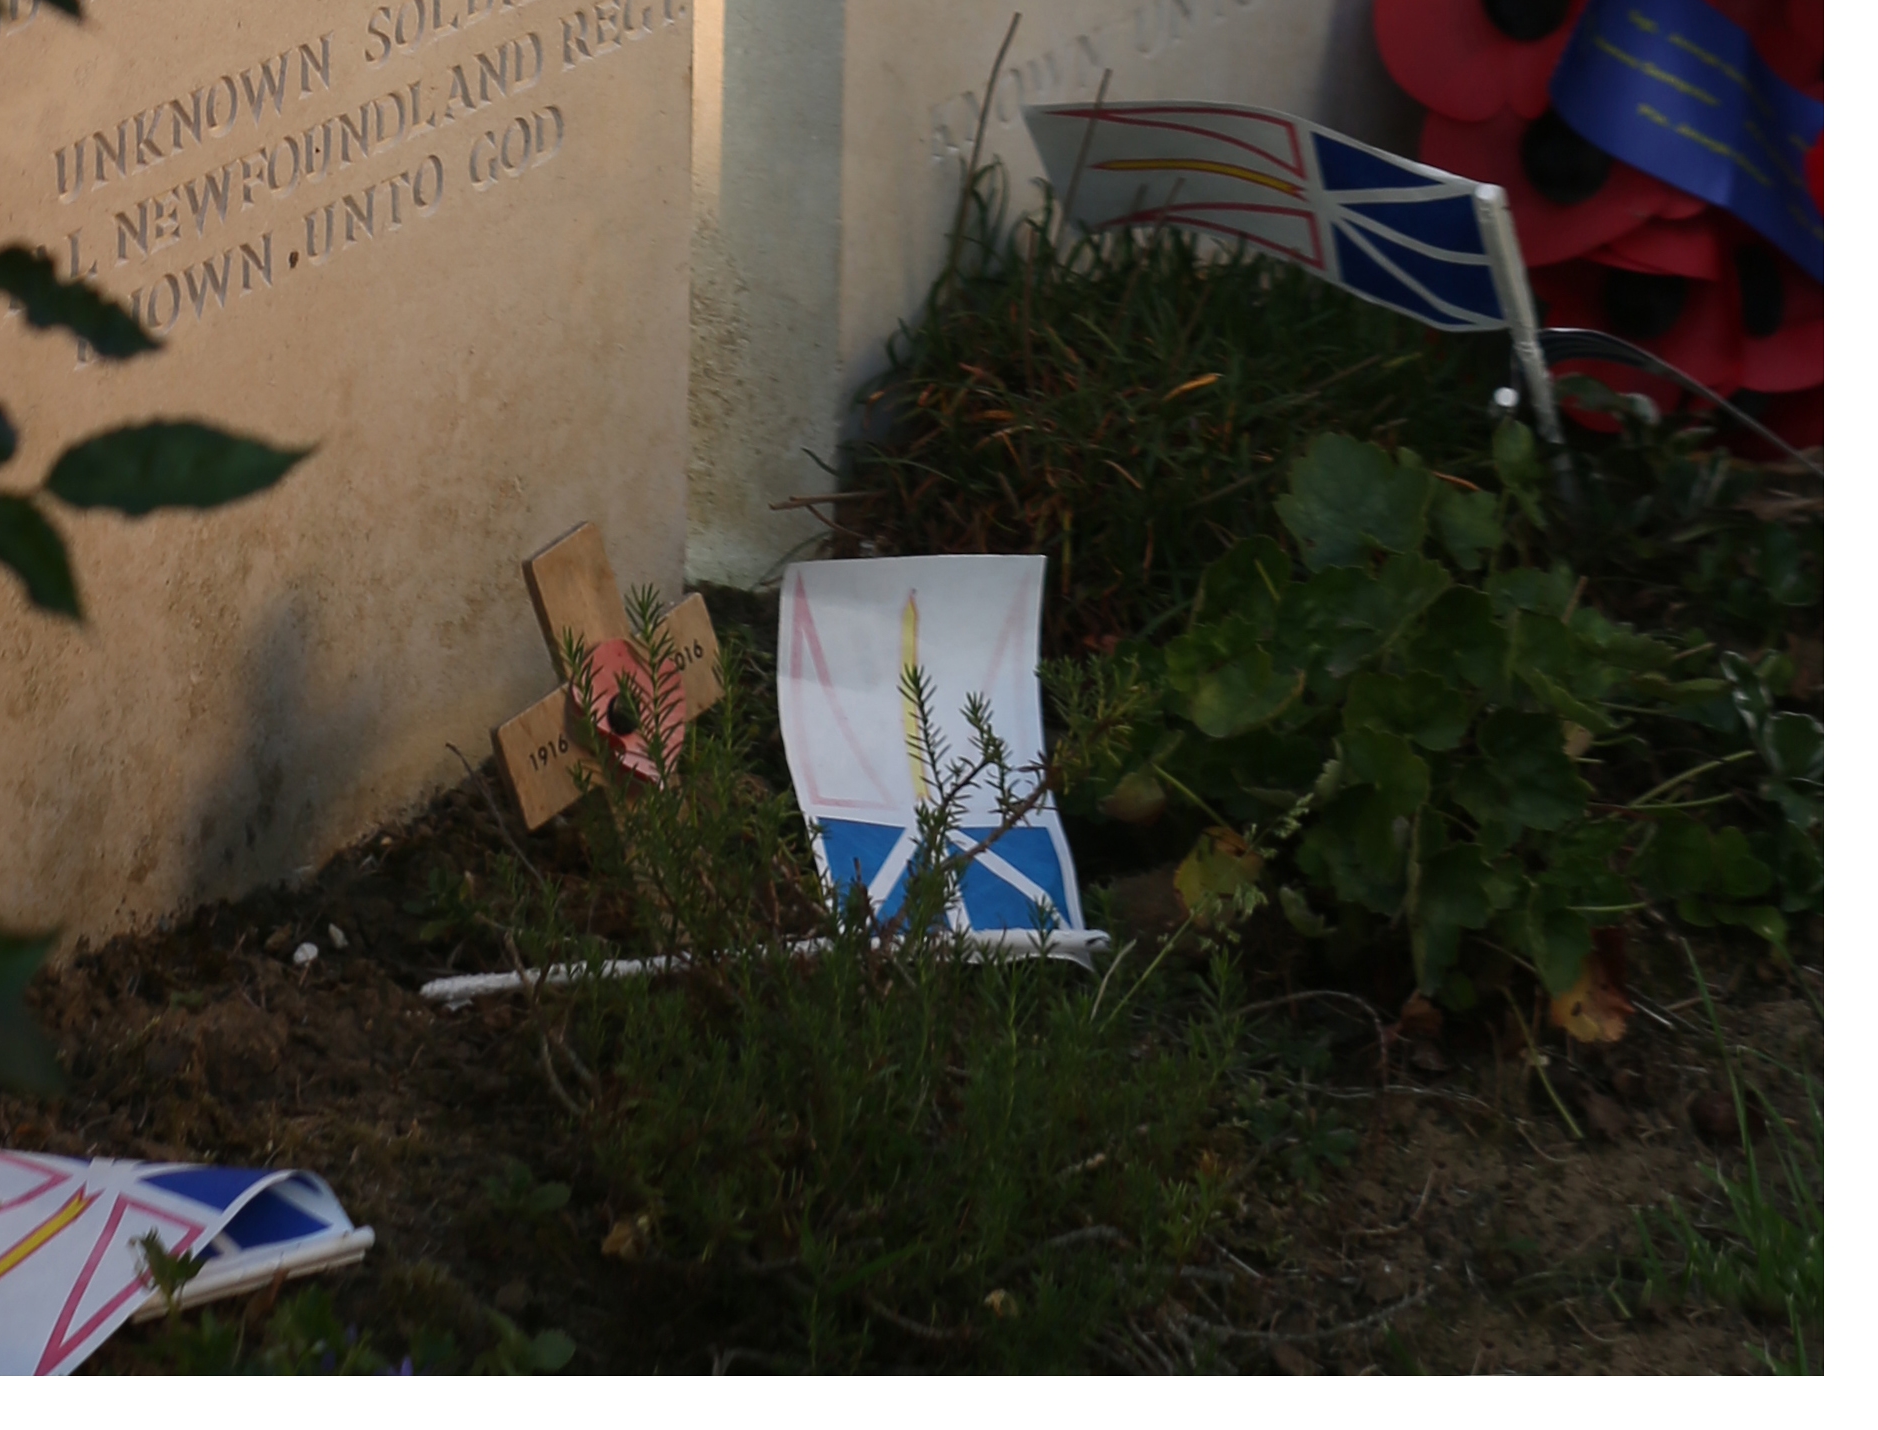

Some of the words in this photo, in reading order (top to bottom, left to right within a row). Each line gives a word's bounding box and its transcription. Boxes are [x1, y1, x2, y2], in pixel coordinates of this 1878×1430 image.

[53, 30, 336, 205] UNKNOWN
[114, 29, 544, 264] NEWFOUNDLAND
[301, 152, 445, 268] UNTO
[468, 104, 566, 193] GOD
[527, 733, 570, 773] 1916
